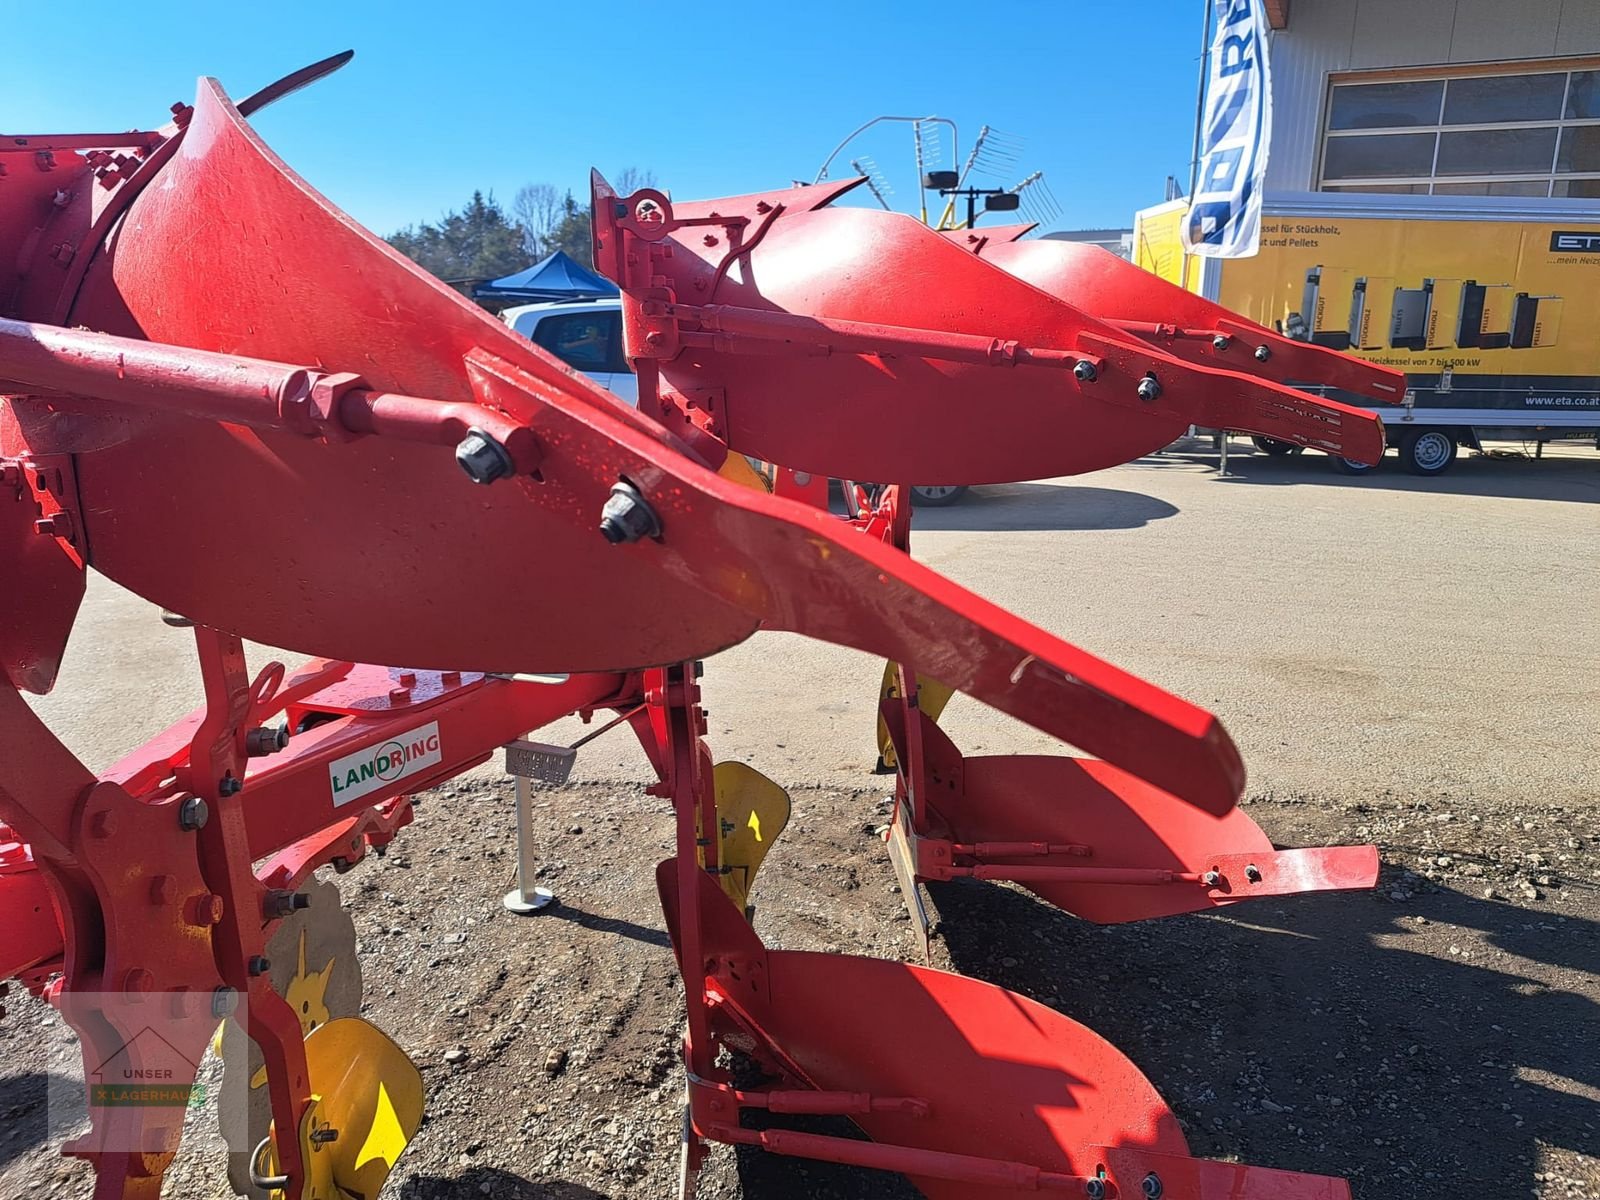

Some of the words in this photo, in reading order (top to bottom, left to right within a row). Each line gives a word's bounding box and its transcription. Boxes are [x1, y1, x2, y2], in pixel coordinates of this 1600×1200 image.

[1261, 225, 1278, 233] ssel
[1281, 224, 1294, 233] für
[1295, 225, 1341, 235] Stückholz,
[1269, 238, 1287, 247] und
[1288, 239, 1319, 248] Pellets
[1315, 296, 1326, 331] HACKGUT
[1394, 308, 1404, 335] PELLETS
[1482, 308, 1491, 333] PELLETS
[1533, 322, 1543, 346] PELLETS
[1369, 356, 1411, 366] Heizkessel
[1429, 358, 1435, 366] 7
[1449, 358, 1466, 367] 500
[1467, 358, 1481, 367] kW
[1525, 396, 1600, 406] www.eta.co.at
[332, 734, 439, 793] LANDRING
